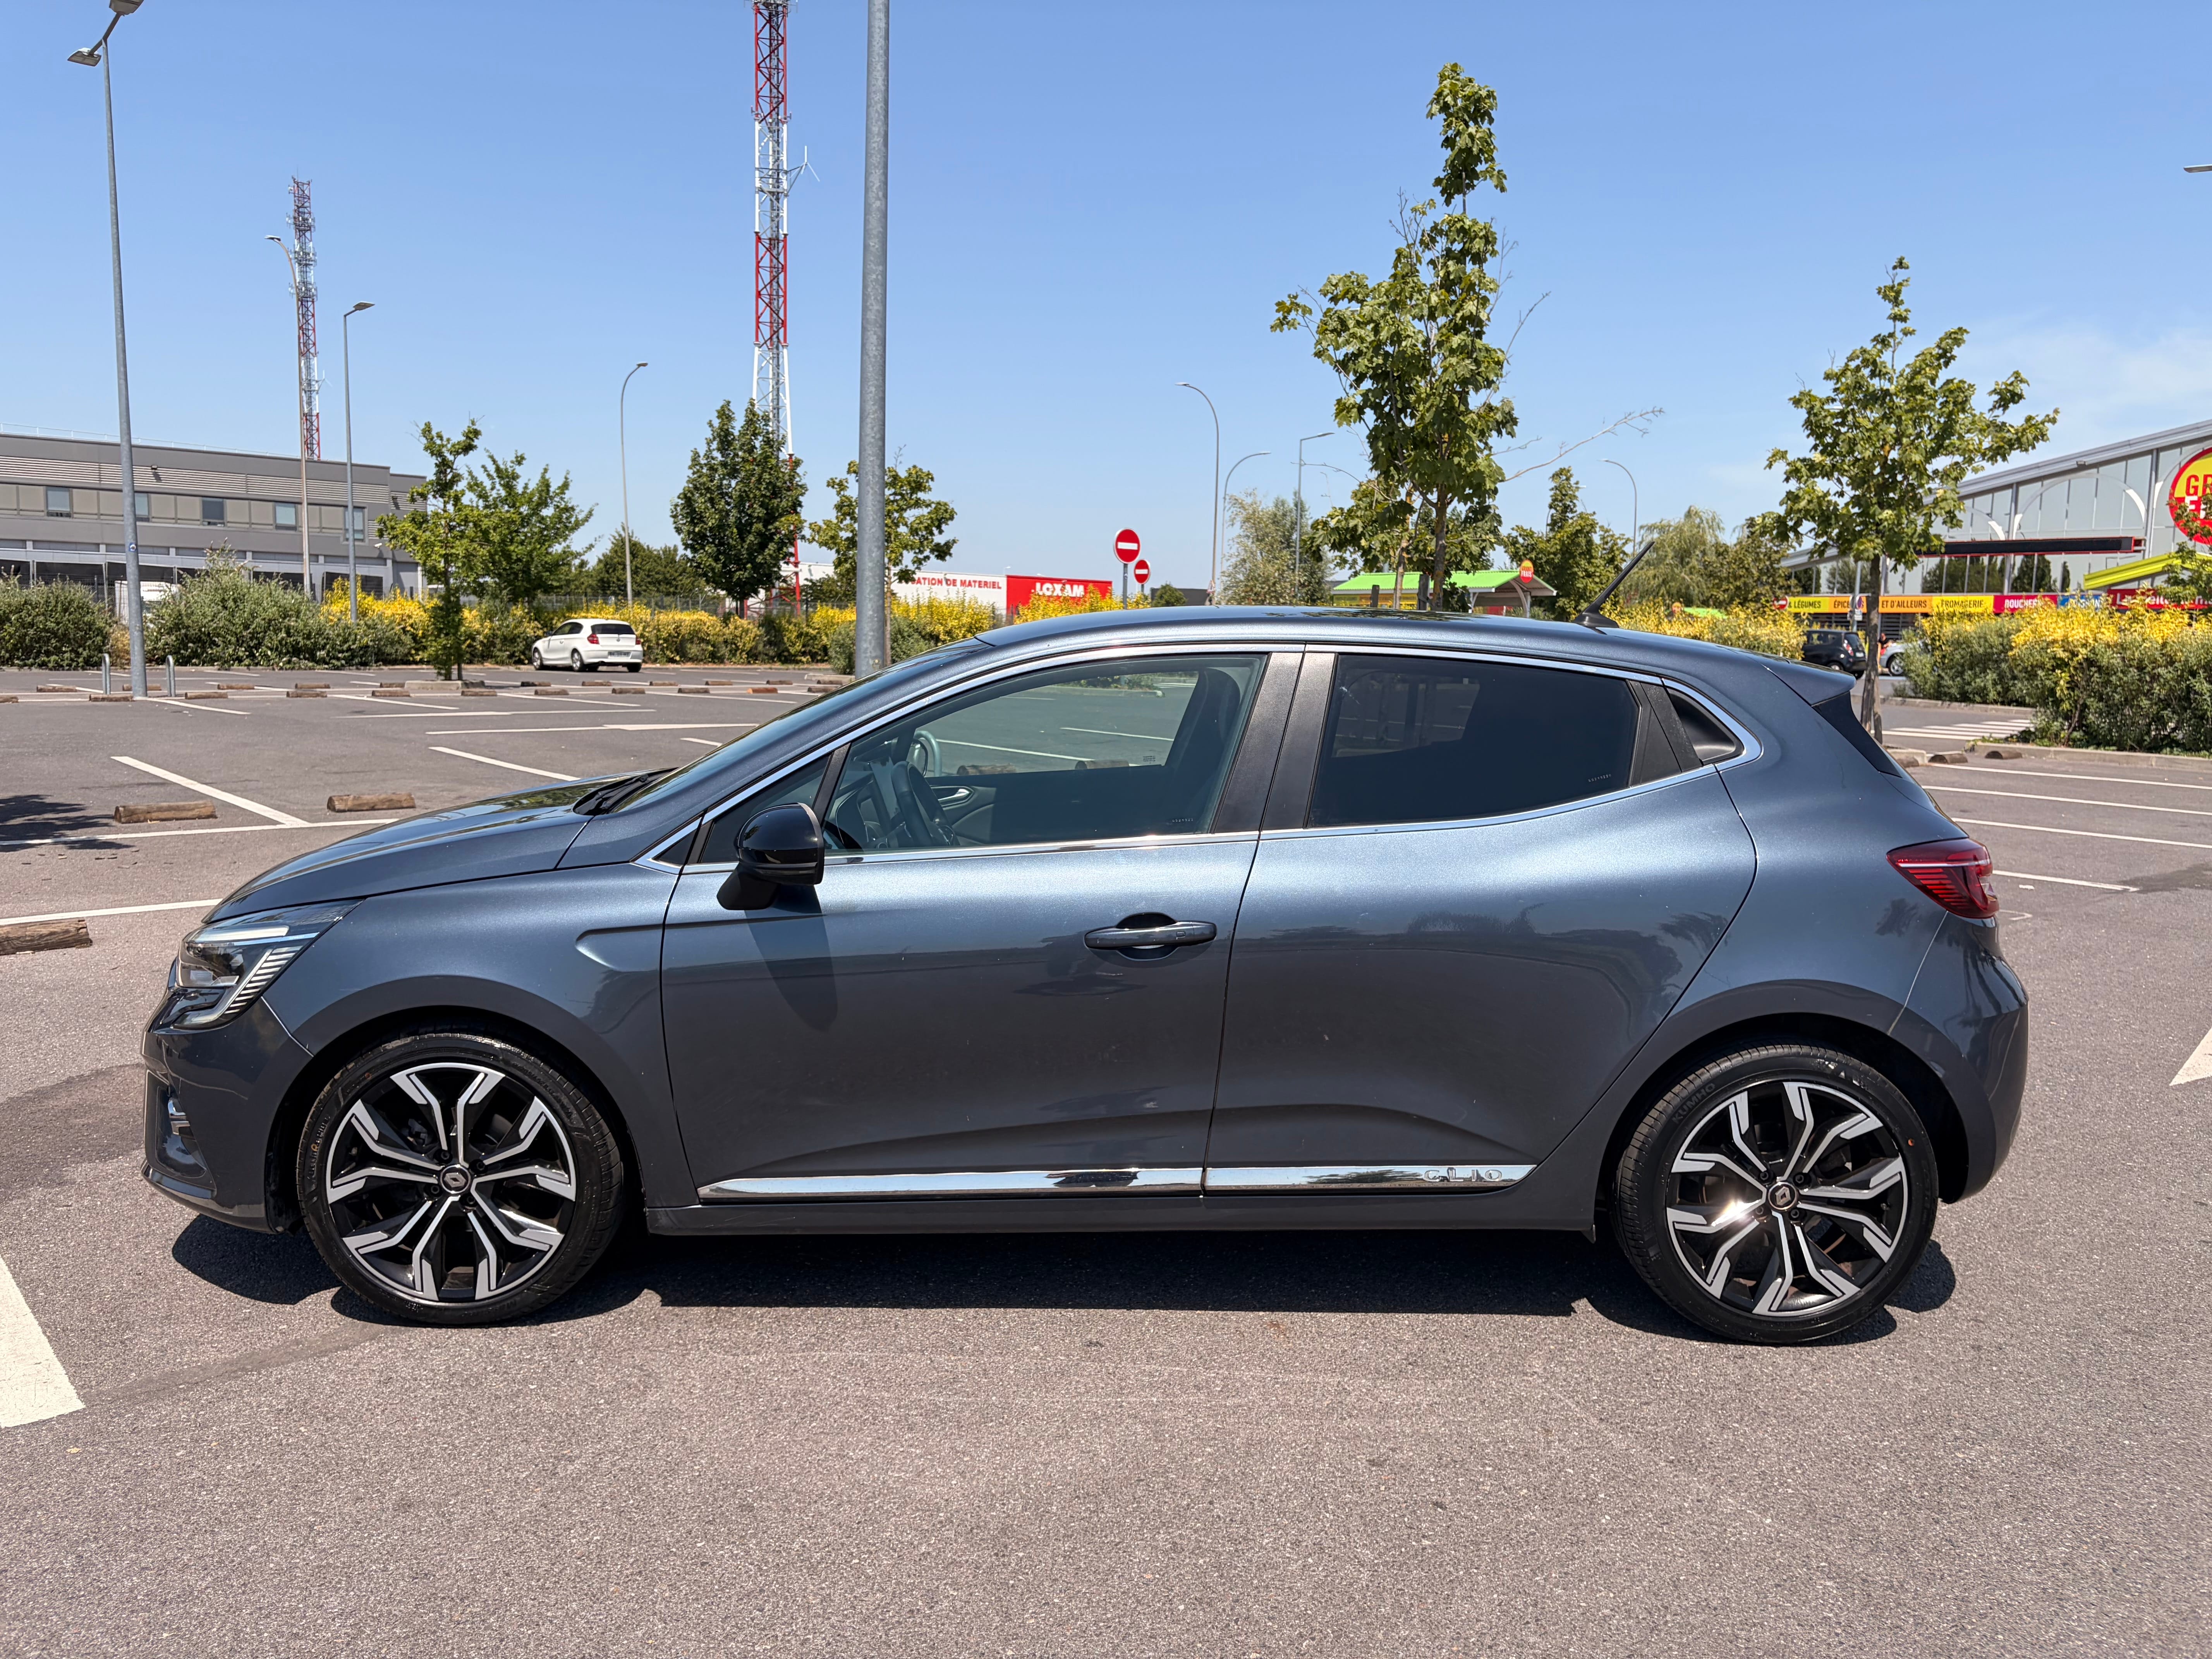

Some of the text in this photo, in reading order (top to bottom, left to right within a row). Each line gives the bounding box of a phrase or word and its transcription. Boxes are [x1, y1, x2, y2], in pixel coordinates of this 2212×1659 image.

[946, 578, 957, 587] DE
[960, 579, 1002, 589] MATERIEL
[1036, 582, 1085, 597] LOXAM
[1794, 600, 1821, 609] LÉGUMES
[1881, 600, 1889, 608] ET
[1890, 600, 1927, 608] D'AILLEURS
[1672, 1083, 1716, 1124] KUMHO
[1424, 1169, 1503, 1182] CLIO
